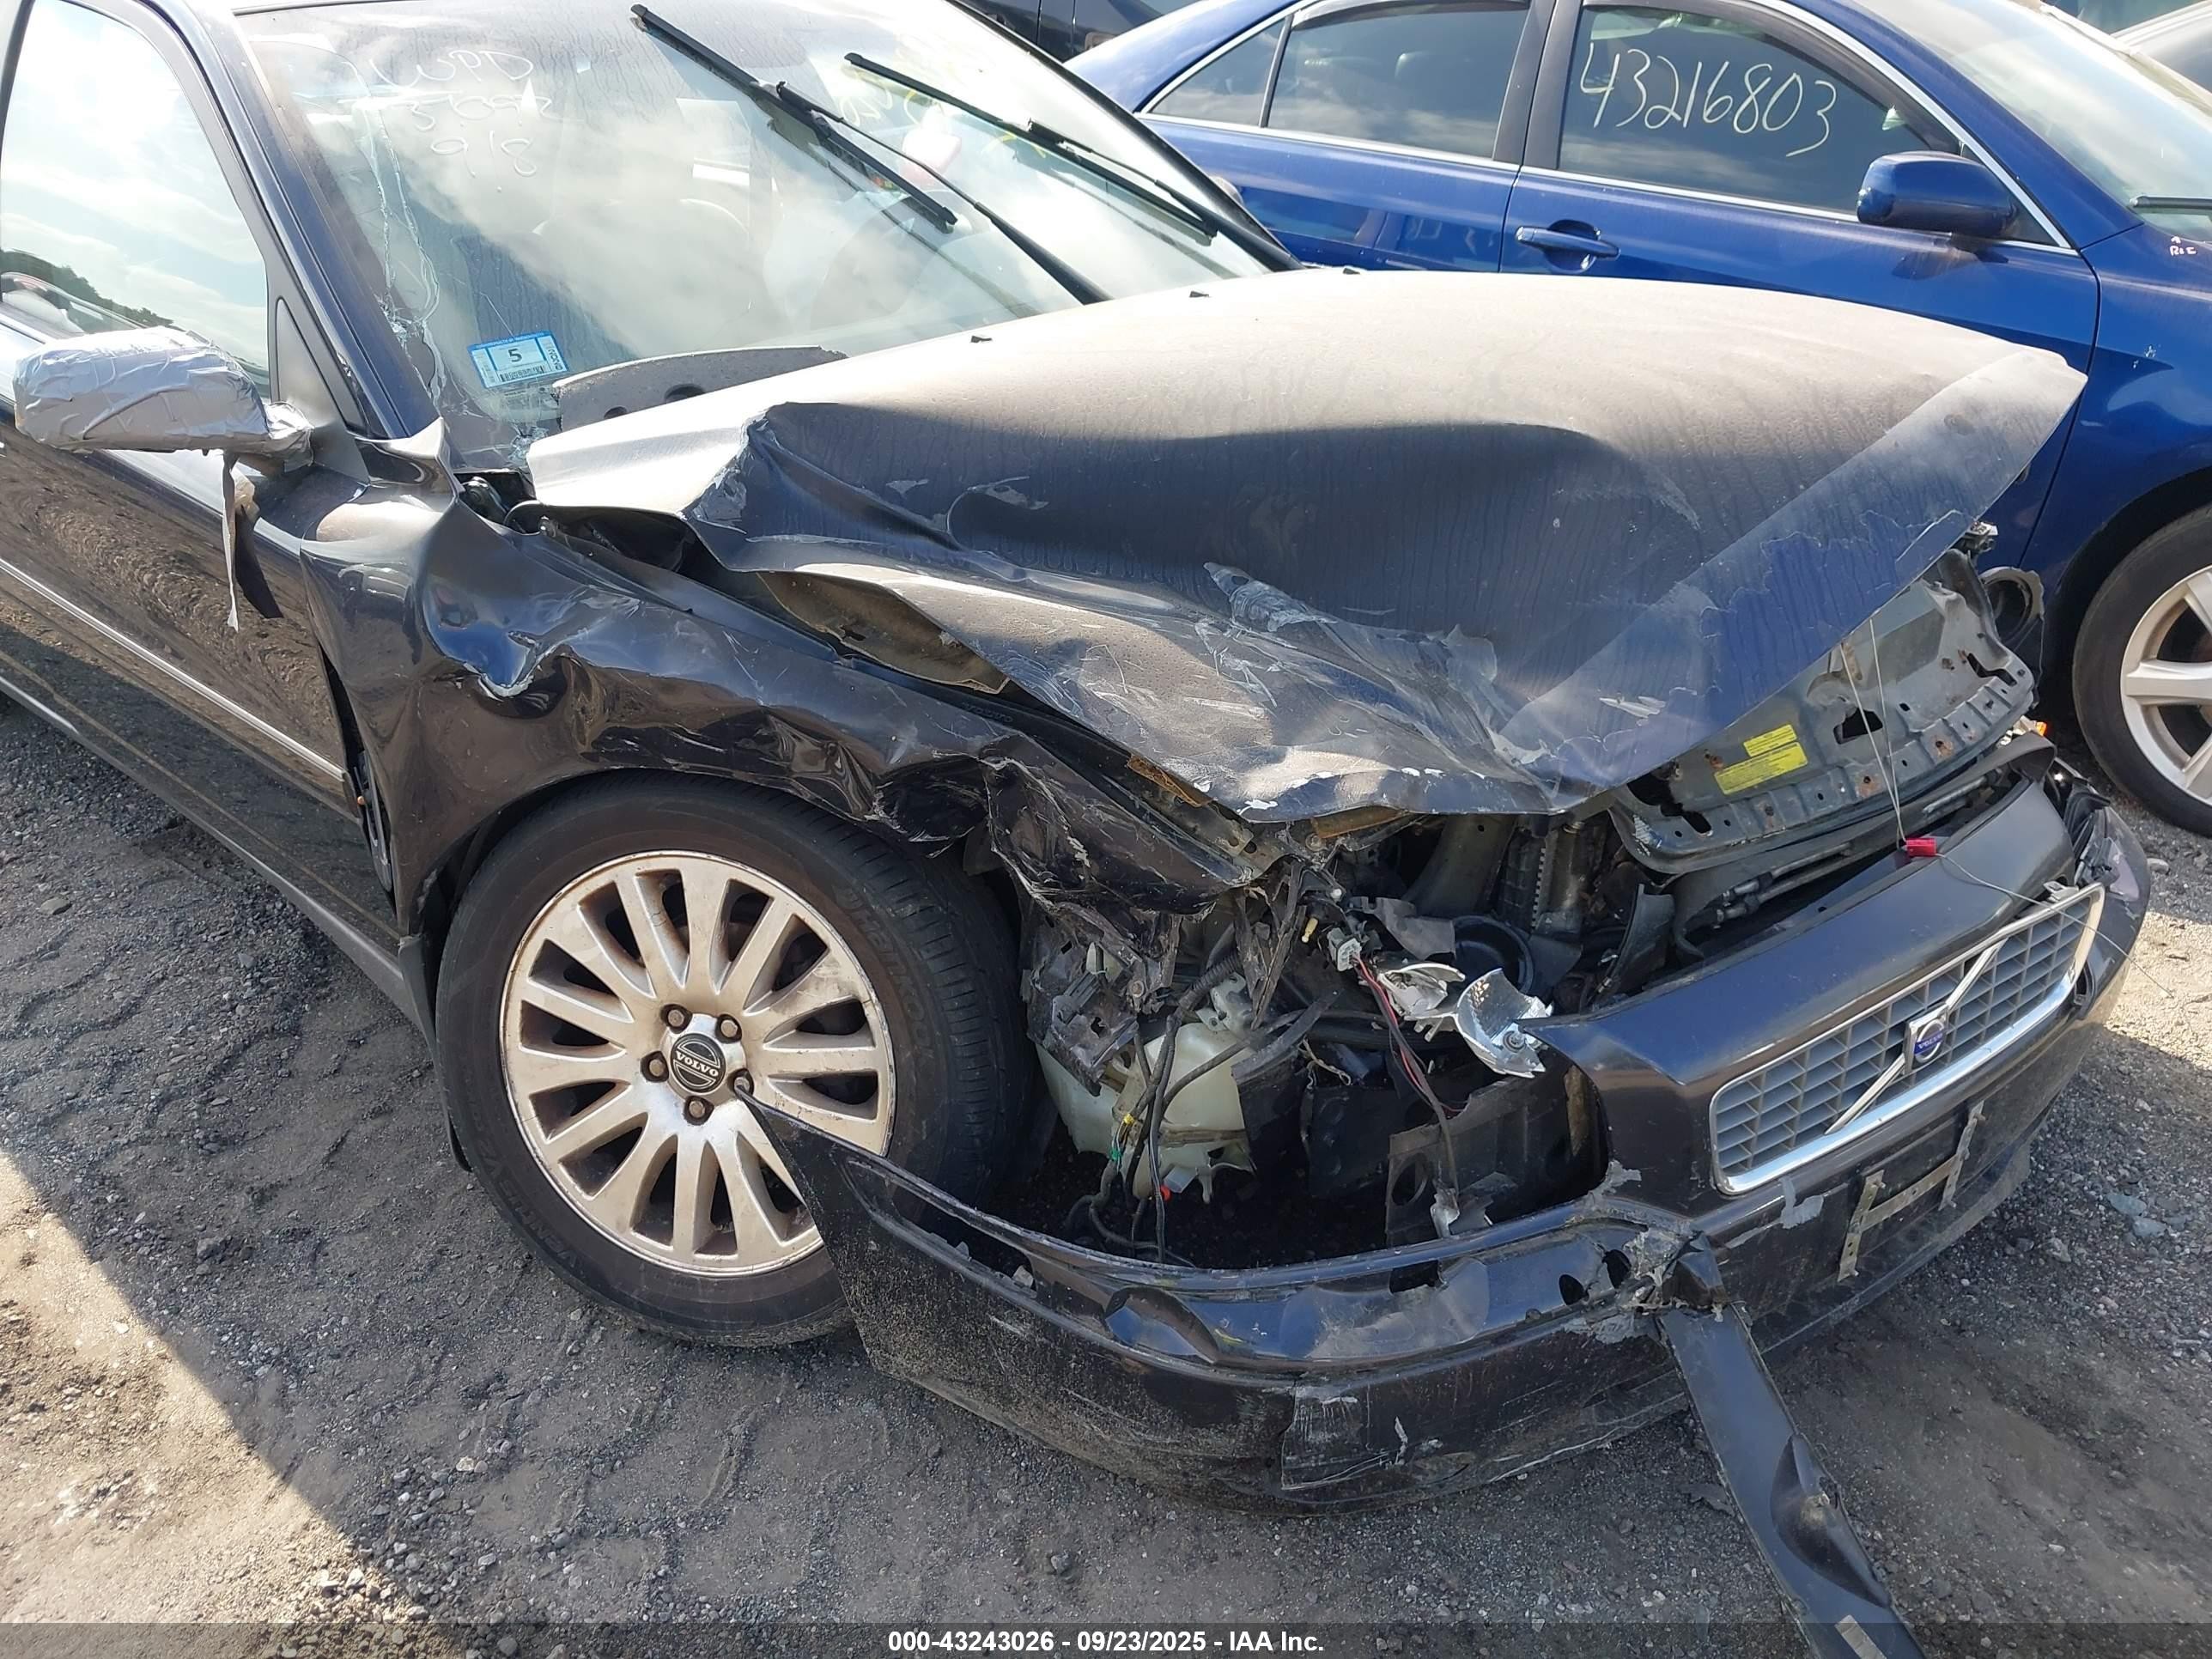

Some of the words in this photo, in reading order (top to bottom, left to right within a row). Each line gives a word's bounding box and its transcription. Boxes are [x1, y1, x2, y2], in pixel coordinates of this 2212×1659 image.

[1580, 41, 1836, 156] 43216803
[507, 348, 523, 363] 5
[1917, 1033, 1944, 1049] VOLVO
[675, 1050, 720, 1078] VOLVO
